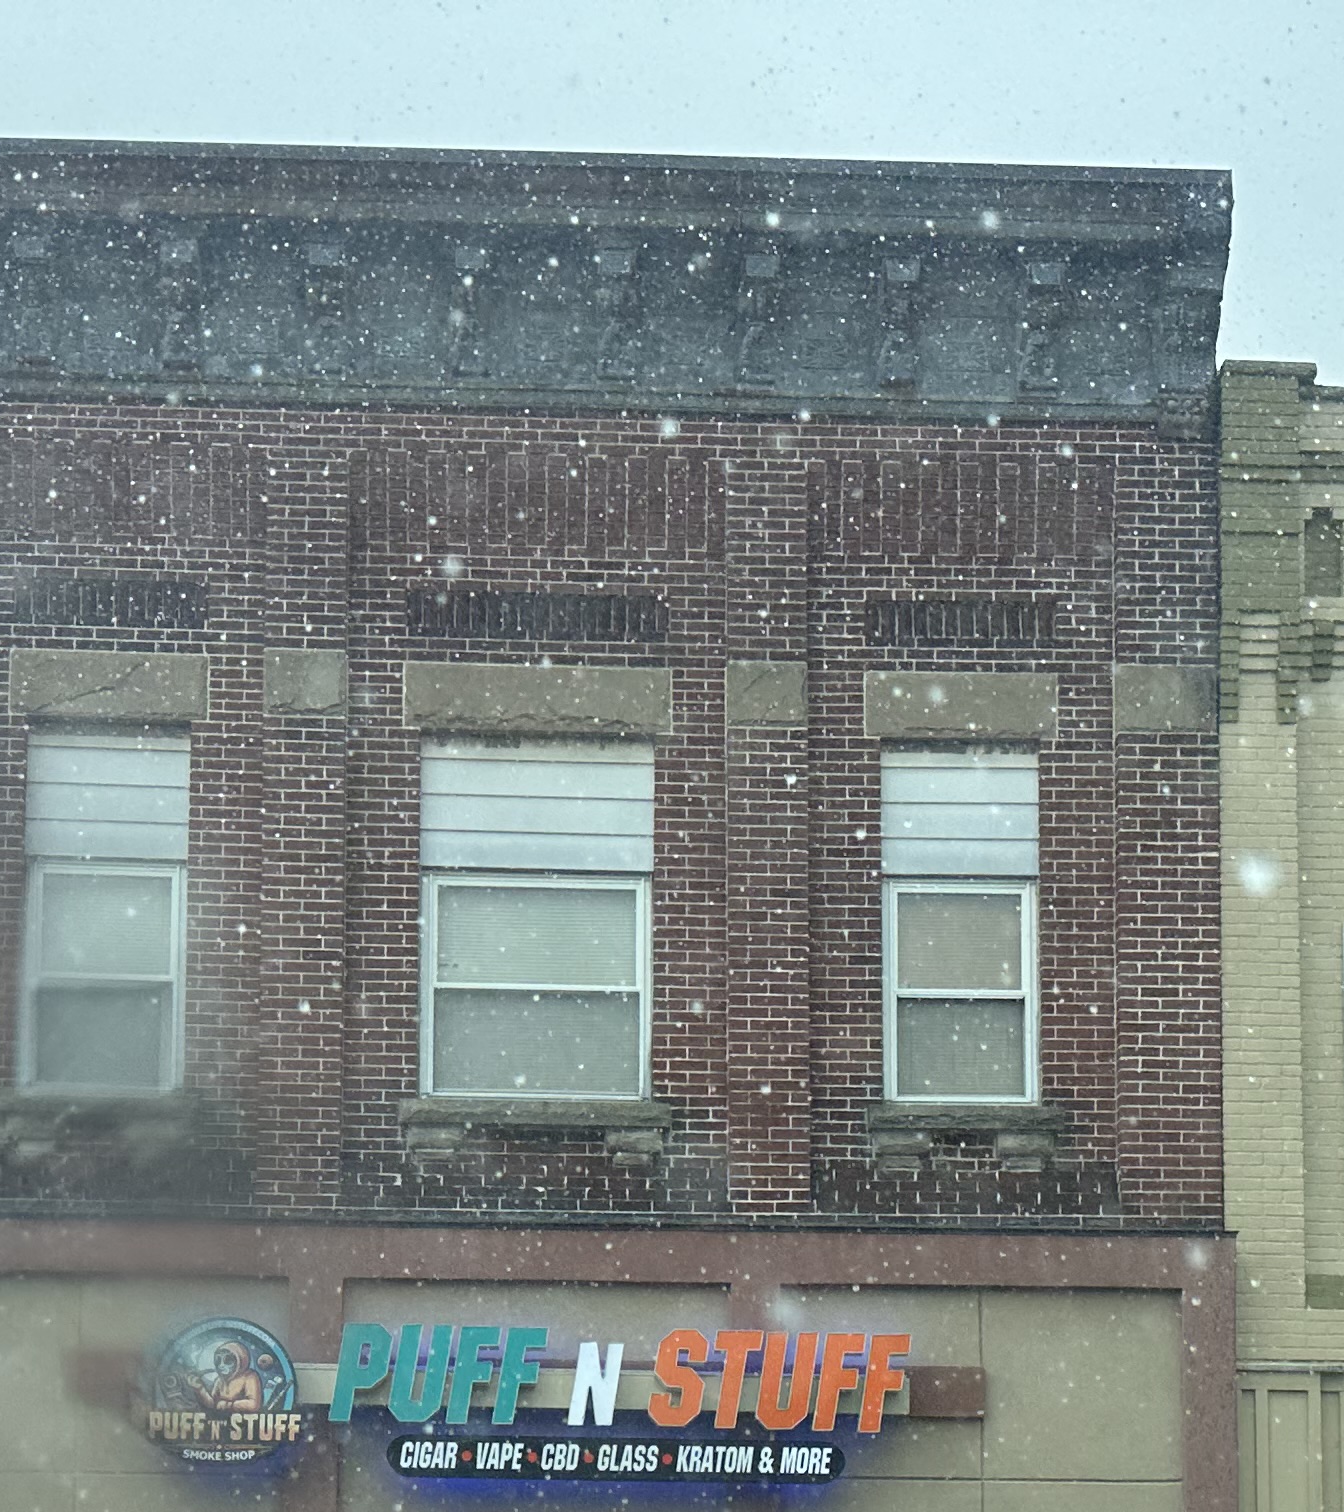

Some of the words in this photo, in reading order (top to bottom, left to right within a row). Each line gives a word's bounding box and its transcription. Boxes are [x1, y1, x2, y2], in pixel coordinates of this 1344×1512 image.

[328, 1323, 549, 1425] PUFF
[567, 1342, 624, 1426] N
[648, 1328, 912, 1433] STUFF
[149, 1411, 205, 1440] PUFF
[230, 1412, 301, 1441] STUFF
[182, 1449, 222, 1460] SMOKE
[225, 1449, 255, 1460] SHOP
[400, 1441, 458, 1469] CIGAR
[475, 1442, 524, 1470] VAPE
[541, 1443, 580, 1471] CBD
[597, 1444, 659, 1472] GLASS
[676, 1445, 754, 1473] KRATOM
[758, 1446, 774, 1474] &
[780, 1447, 833, 1475] MORE
